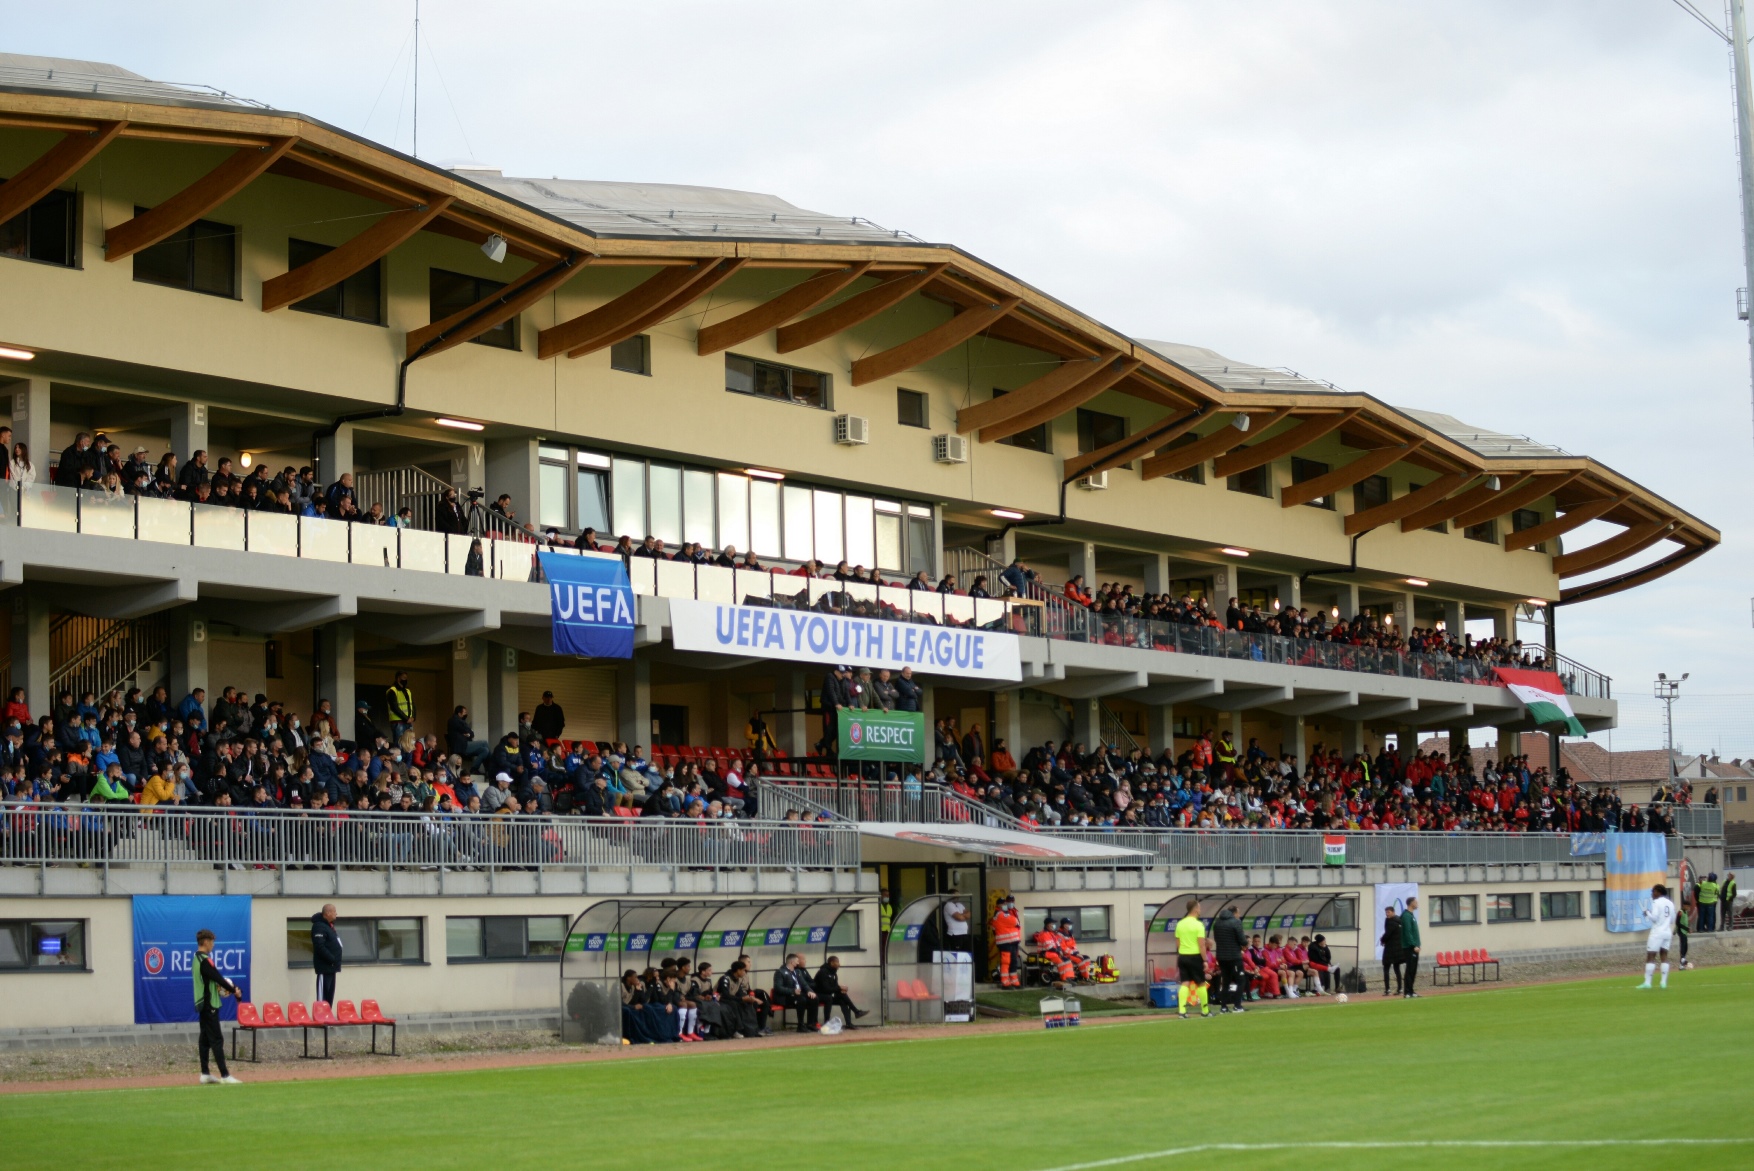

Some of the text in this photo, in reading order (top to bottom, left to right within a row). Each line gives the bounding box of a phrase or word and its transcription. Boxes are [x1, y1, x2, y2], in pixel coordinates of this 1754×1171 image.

[194, 403, 205, 425] E
[473, 446, 483, 466] V
[1087, 543, 1093, 558] F
[1294, 577, 1300, 590] G
[553, 583, 633, 624] UEFA
[193, 620, 205, 642] B
[716, 606, 984, 669] UEFA YOUTH LEAGUE
[506, 647, 516, 668] B
[866, 725, 915, 745] RESPECT
[1664, 905, 1670, 917] 9
[171, 949, 245, 971] REECT
